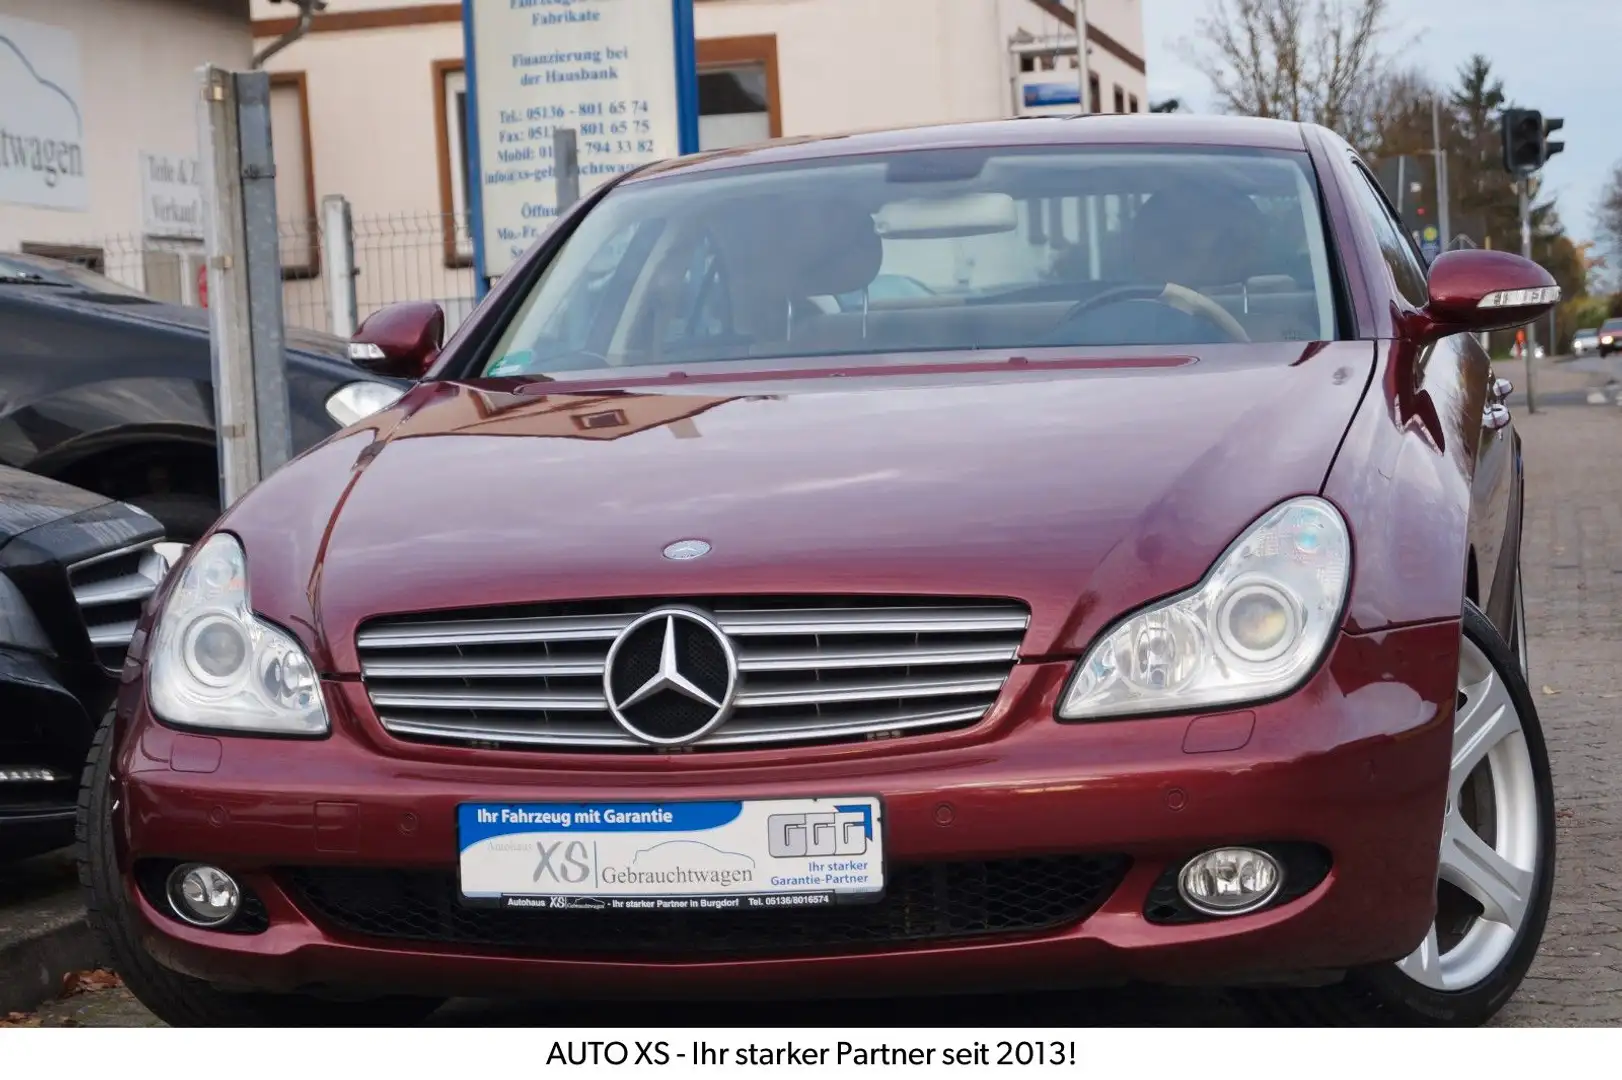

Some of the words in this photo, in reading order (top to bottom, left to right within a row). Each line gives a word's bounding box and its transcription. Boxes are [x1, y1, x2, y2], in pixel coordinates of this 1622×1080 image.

[532, 10, 600, 26] Fabrikate
[512, 50, 602, 68] Finanzierung
[606, 46, 628, 60] bei
[520, 73, 541, 86] der
[546, 66, 618, 84] Hausbank
[526, 105, 565, 120] 05136
[579, 102, 602, 116] 801
[609, 101, 626, 114] 65
[632, 100, 648, 114] 74
[499, 130, 523, 143] Fax:
[580, 122, 604, 136] 801
[610, 120, 627, 134] 65
[633, 119, 649, 133] 75
[0, 128, 83, 189] twagen
[497, 146, 535, 162] Mobil:
[585, 141, 610, 155] 794
[617, 140, 632, 152] 33
[637, 139, 653, 153] 82
[152, 196, 198, 223] Verkauf
[477, 808, 498, 823] Ihr
[502, 809, 571, 826] Fahrzeug
[575, 809, 600, 823] mit
[604, 809, 673, 824] Garantie
[487, 840, 532, 851] Autohaus
[533, 841, 590, 883] XS
[602, 866, 753, 887] Gebrauchtwagen
[808, 861, 824, 872] Ihr
[828, 860, 868, 872] starker
[770, 874, 868, 886] Garantie-Partner
[507, 898, 546, 907] Autohaus
[549, 896, 565, 909] XS
[612, 899, 625, 908] Ihr
[625, 899, 654, 908] starker
[656, 899, 688, 908] Partner
[690, 899, 699, 908] in
[700, 898, 740, 909] Burgdorf
[748, 897, 764, 906] Tel.
[766, 895, 829, 905] 05136/8016574
